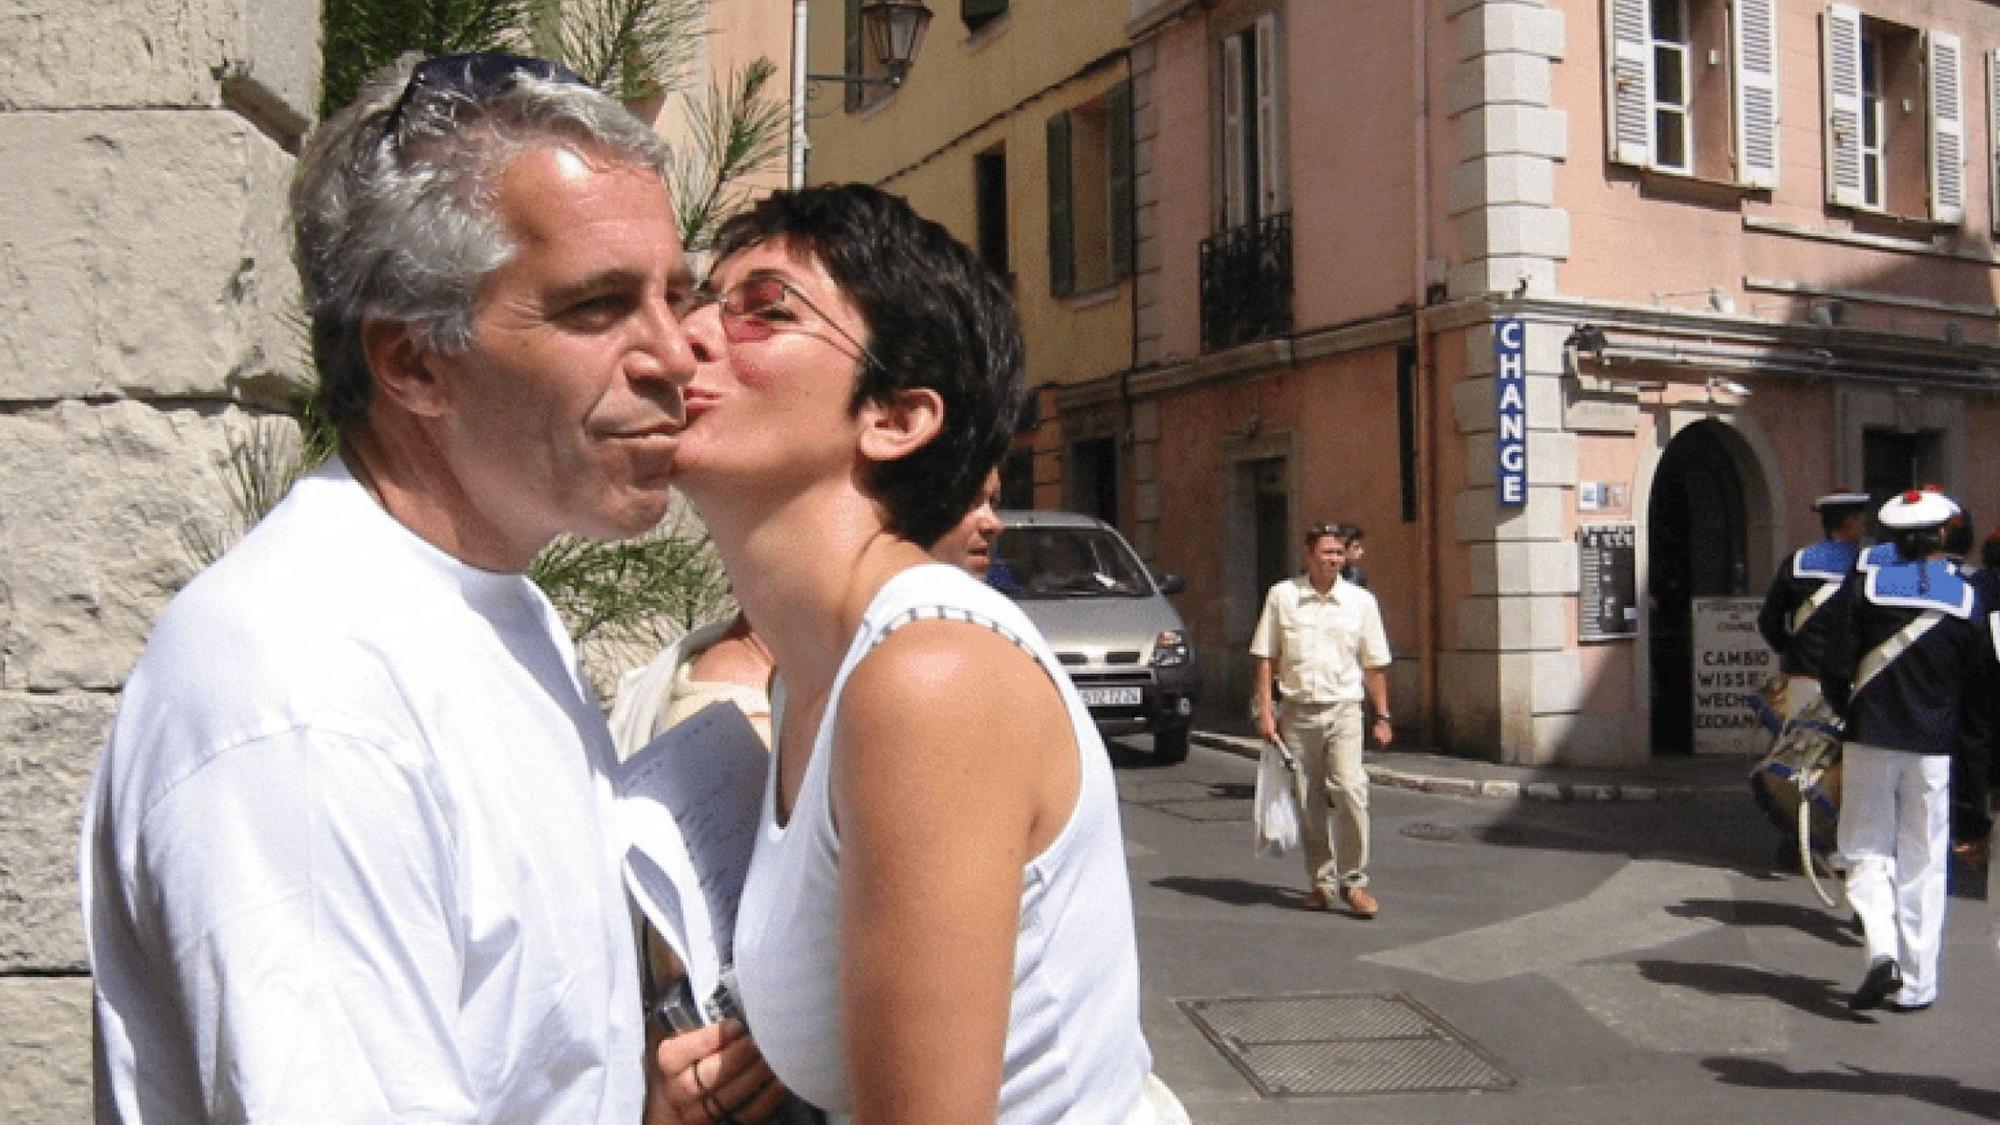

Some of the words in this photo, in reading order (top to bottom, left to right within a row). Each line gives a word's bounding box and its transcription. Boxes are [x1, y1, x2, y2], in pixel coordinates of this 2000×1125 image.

[1500, 322, 1524, 502] CHANGE
[1703, 650, 1769, 666] CAMBIO
[1697, 693, 1746, 707] WECH
[1696, 714, 1757, 728] EXCHAN
